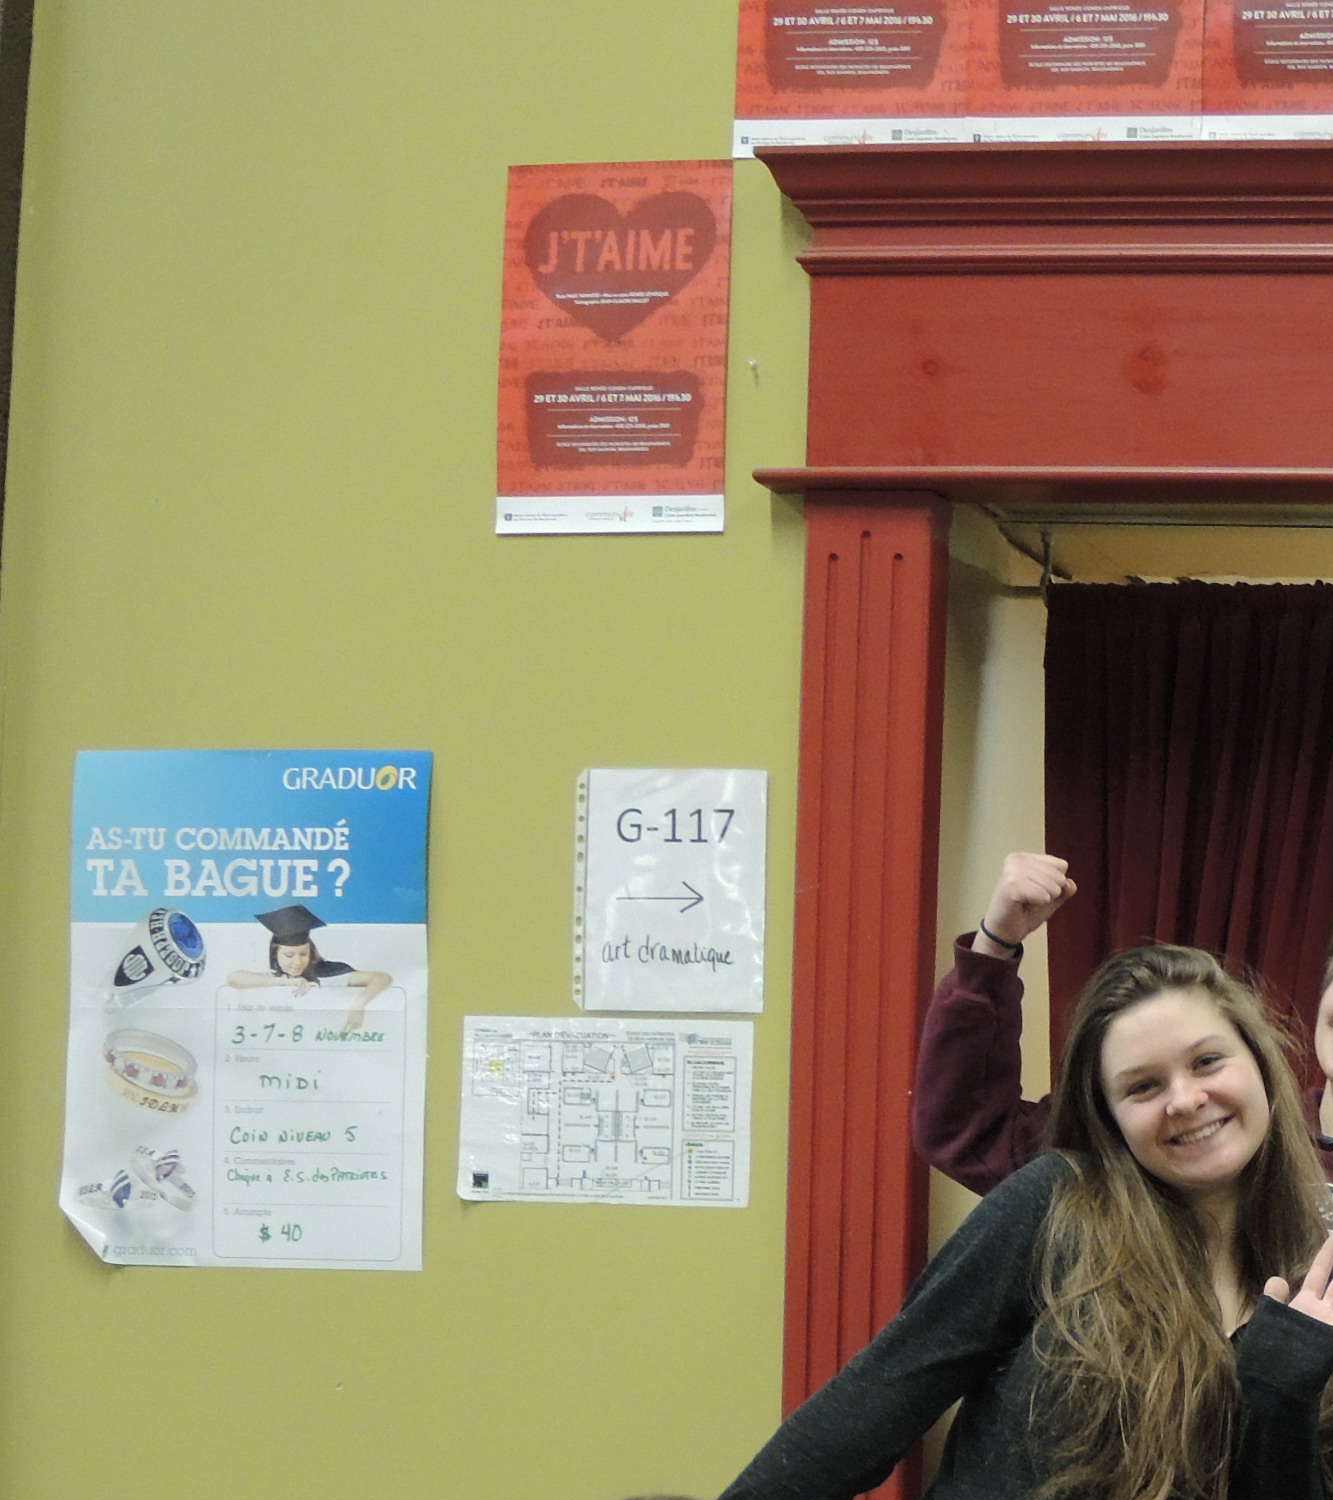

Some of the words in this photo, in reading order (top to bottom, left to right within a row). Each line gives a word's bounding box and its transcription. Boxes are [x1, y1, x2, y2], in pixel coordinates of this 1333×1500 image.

[537, 228, 695, 273] J'T'AIME
[282, 765, 416, 791] GRADUOR
[86, 826, 166, 851] AS-TU
[175, 818, 350, 851] COMMANDÉ
[616, 807, 736, 843] G-117
[86, 858, 149, 897] TA
[164, 858, 319, 897] BAGUE
[326, 858, 351, 897] ?
[601, 935, 632, 964] art
[638, 934, 734, 973] dramatique
[344, 1125, 359, 1142] 5
[281, 1223, 303, 1242] 40
